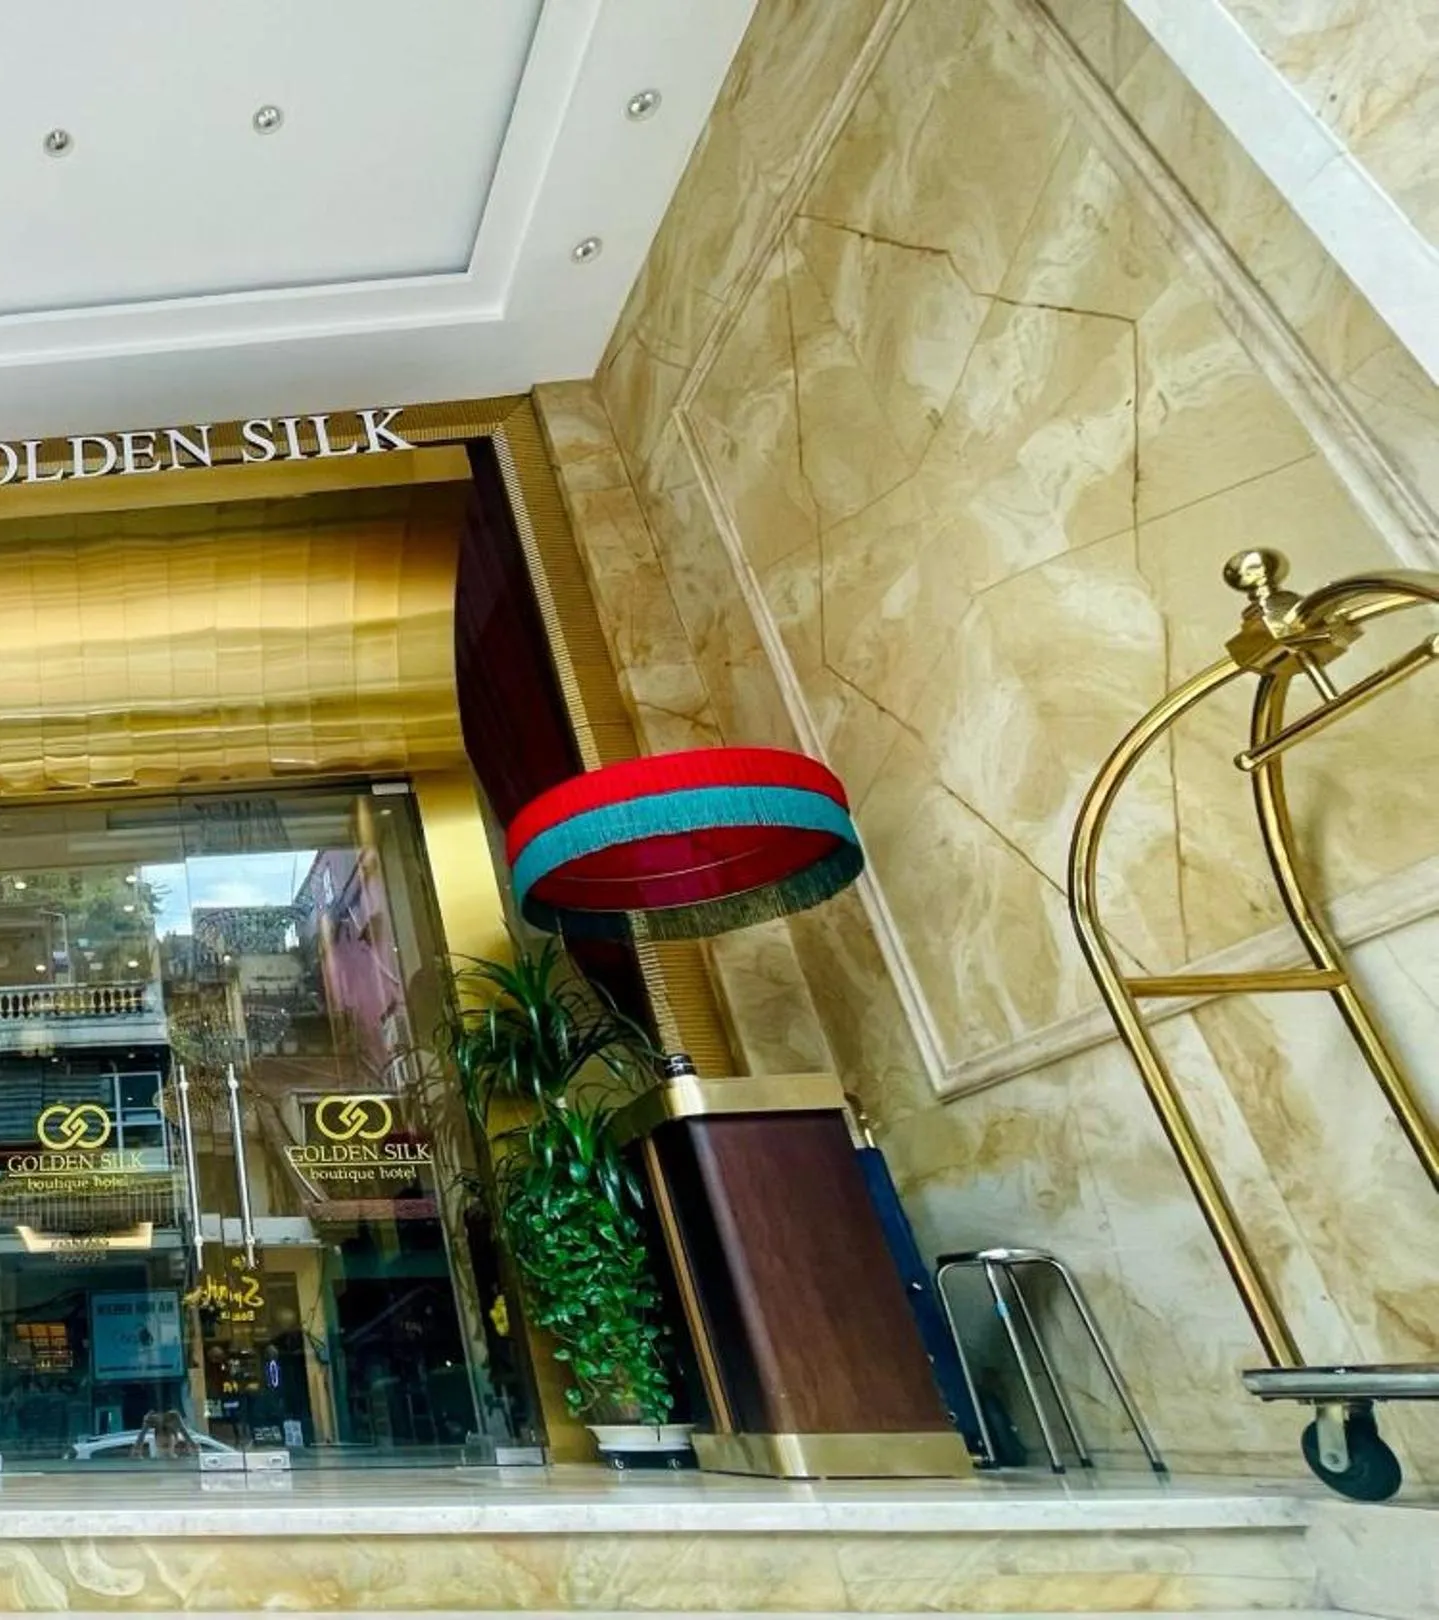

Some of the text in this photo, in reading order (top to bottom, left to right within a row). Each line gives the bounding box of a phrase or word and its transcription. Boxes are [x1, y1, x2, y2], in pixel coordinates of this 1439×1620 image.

[240, 407, 417, 463] SILK
[8, 1151, 144, 1173] GOLDEN SILK
[289, 1143, 431, 1162] GOLDEN SILK
[27, 1174, 129, 1192] boutique hotel
[310, 1165, 417, 1183] boutique hotel
